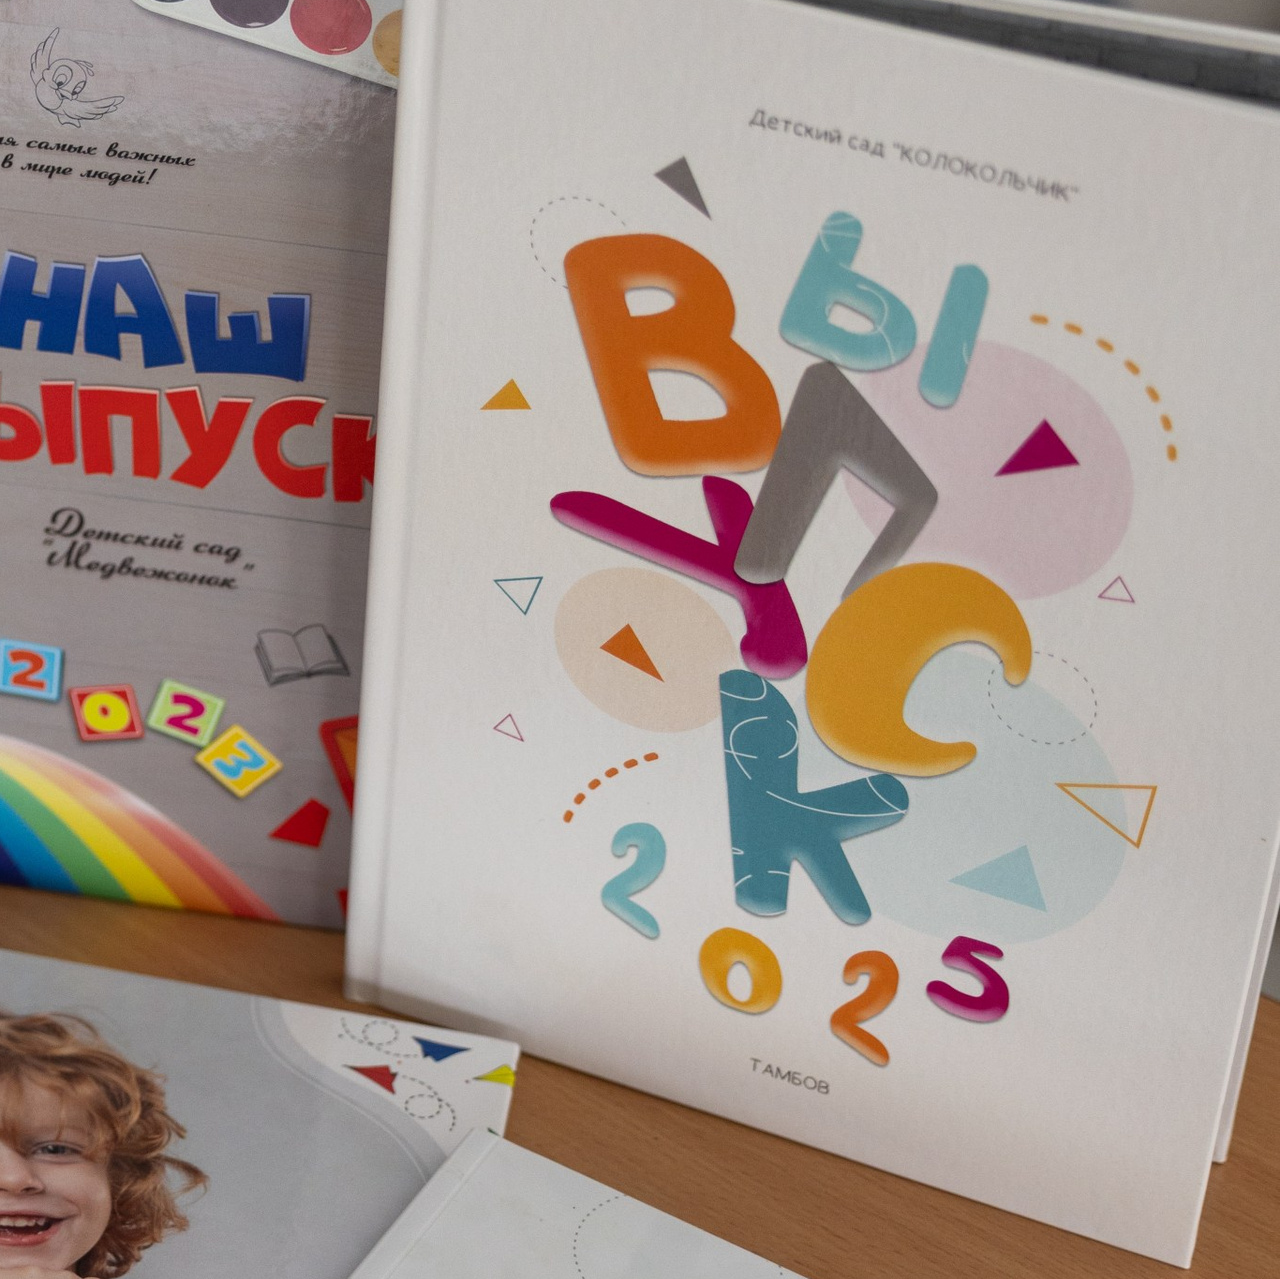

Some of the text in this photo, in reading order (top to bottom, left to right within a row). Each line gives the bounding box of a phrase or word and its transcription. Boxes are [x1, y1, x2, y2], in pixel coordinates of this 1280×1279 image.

[0, 153, 158, 186] в мире людей!
[26, 138, 98, 156] самых
[105, 142, 196, 167] важных
[749, 108, 1079, 202] Детский сад "КОЛОКОЛЬЧИК"
[43, 507, 242, 563] Детский сад
[749, 1057, 830, 1095] ТАМБОВ
